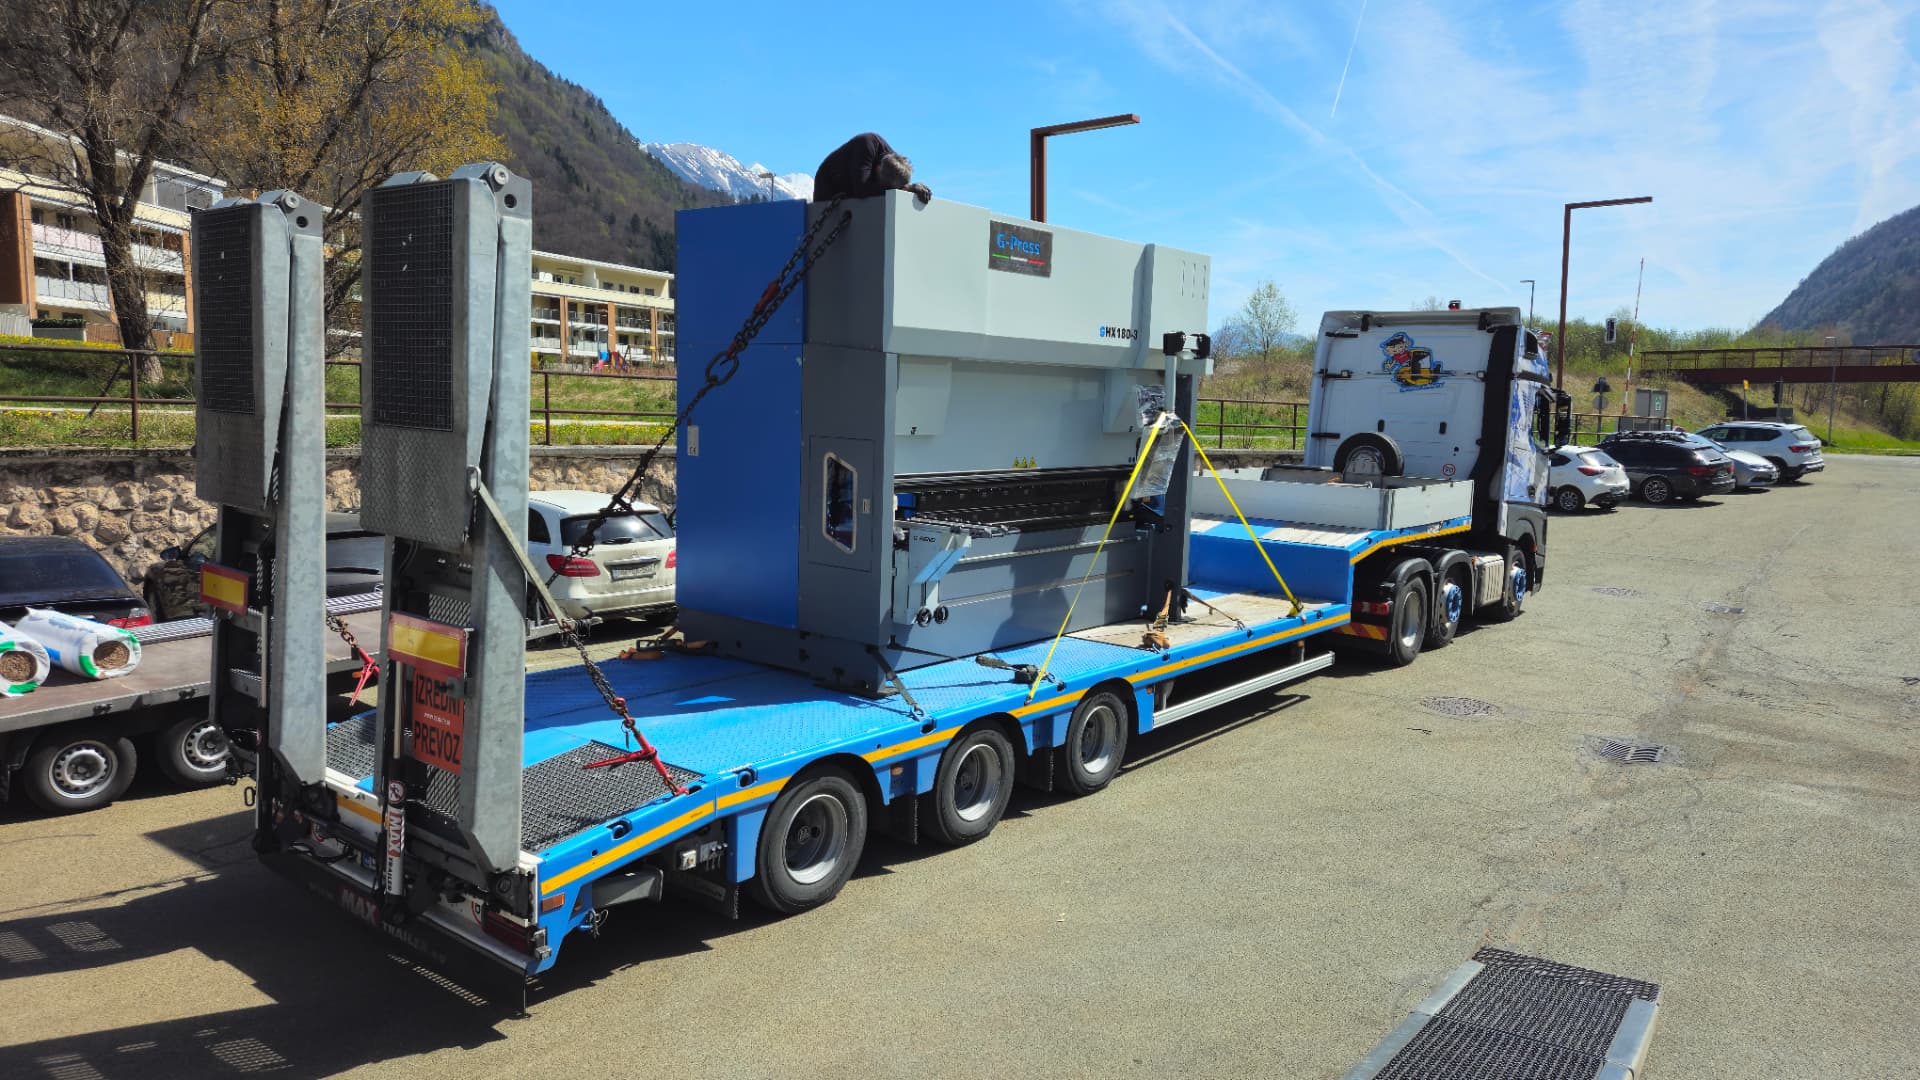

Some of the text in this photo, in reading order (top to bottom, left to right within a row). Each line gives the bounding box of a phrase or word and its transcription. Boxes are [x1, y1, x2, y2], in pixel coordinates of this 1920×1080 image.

[996, 231, 1040, 255] G-Press
[414, 720, 461, 765] PREVOZ
[341, 887, 379, 927] MAX
